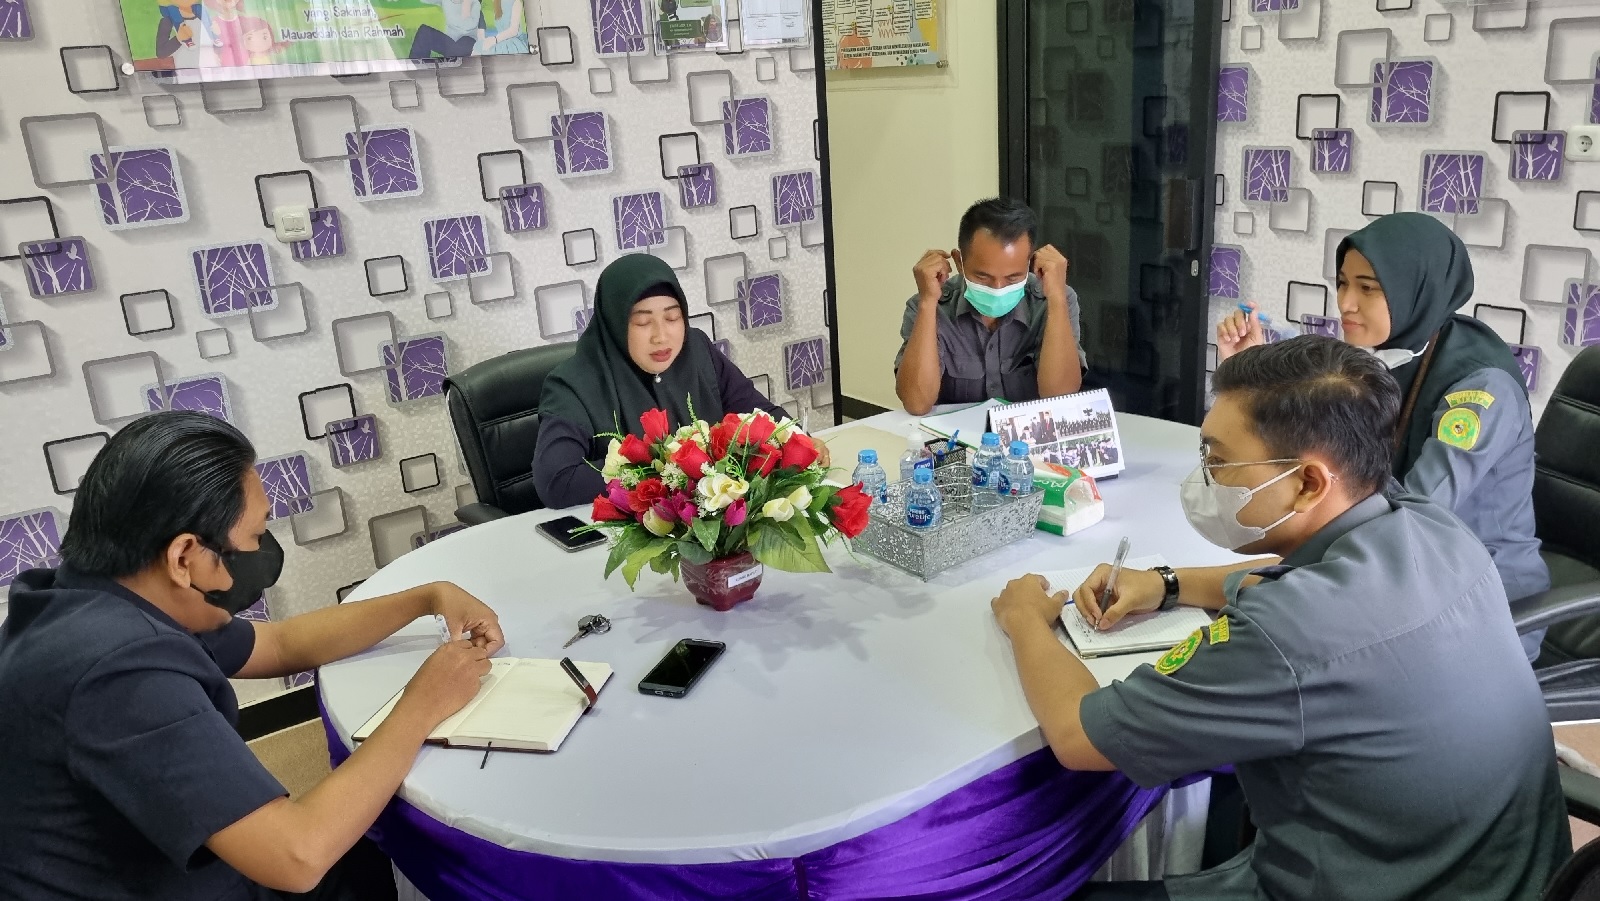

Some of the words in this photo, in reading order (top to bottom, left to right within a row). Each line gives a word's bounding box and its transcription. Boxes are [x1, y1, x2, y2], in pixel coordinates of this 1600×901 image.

[304, 8, 329, 22] yang
[281, 27, 337, 40] Mawaddah
[341, 26, 360, 38] dan
[363, 24, 404, 38] Rahmah
